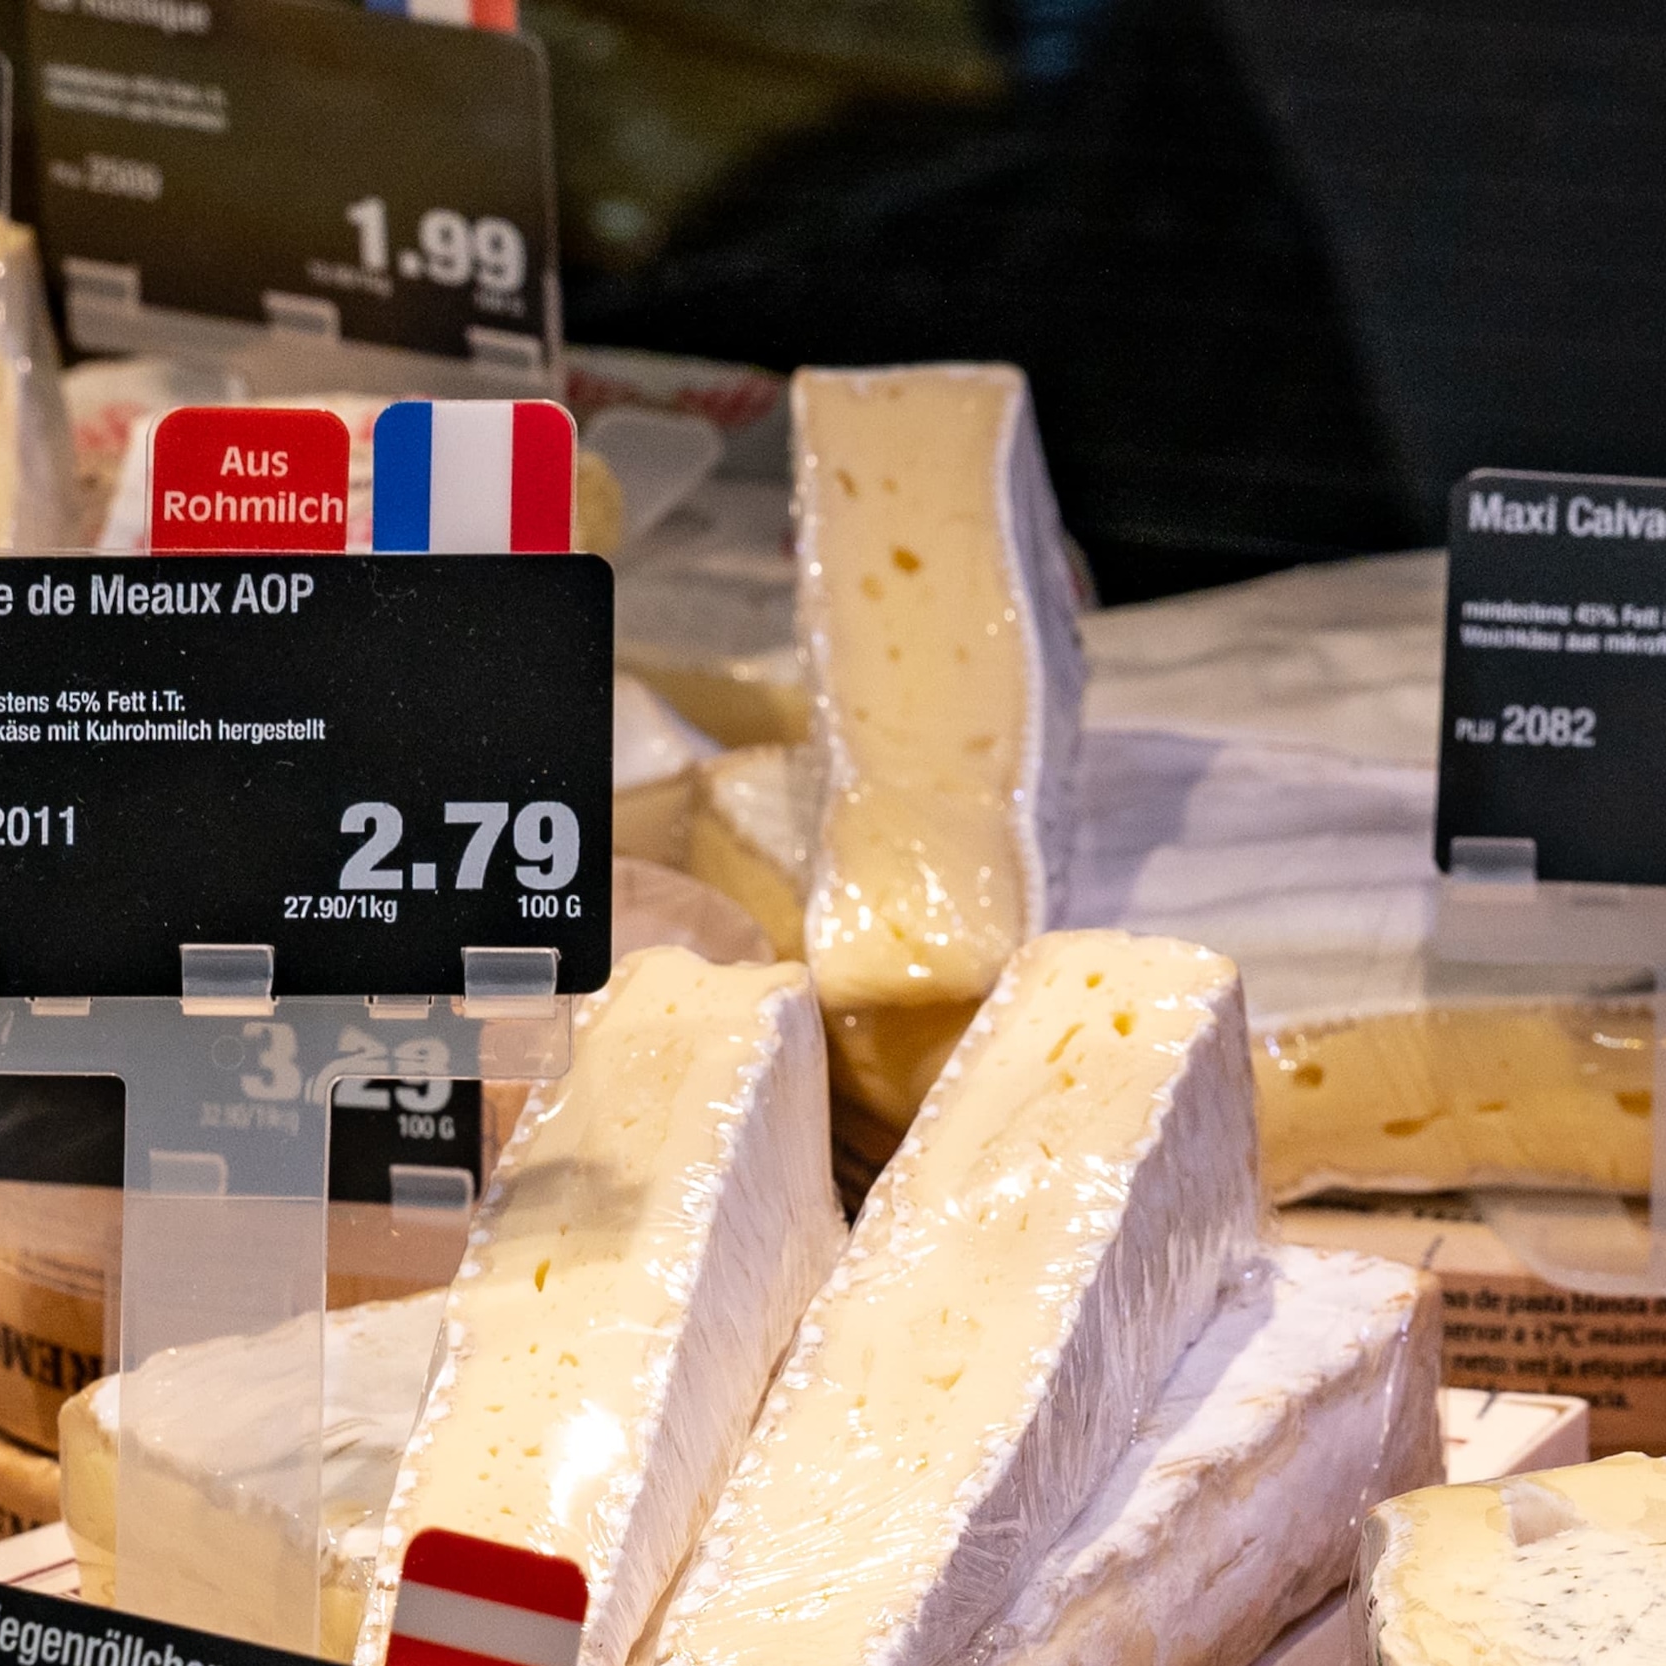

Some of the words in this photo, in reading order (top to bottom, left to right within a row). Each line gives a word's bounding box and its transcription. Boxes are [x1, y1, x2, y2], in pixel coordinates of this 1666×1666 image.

[345, 198, 528, 293] 1.99
[220, 445, 289, 478] Aus
[163, 490, 349, 528] Rohmilch
[1467, 490, 1558, 535] Maxi
[26, 574, 76, 616] de
[90, 573, 222, 615] Meaux
[230, 572, 315, 614] AOP
[55, 690, 101, 713] 45%
[107, 690, 147, 713] Fett
[151, 689, 186, 712] i.Tr.
[47, 719, 81, 742] mit
[85, 718, 212, 742] Kuhrohmilch
[217, 717, 326, 745] hergestellt
[1455, 717, 1496, 743] PLU
[1501, 704, 1597, 747] 2082
[338, 800, 581, 891] 2.79
[283, 894, 398, 924] 27.90/1kg
[517, 894, 559, 918] 100
[564, 893, 582, 918] G
[397, 1113, 435, 1139] 100
[438, 1114, 455, 1141] G
